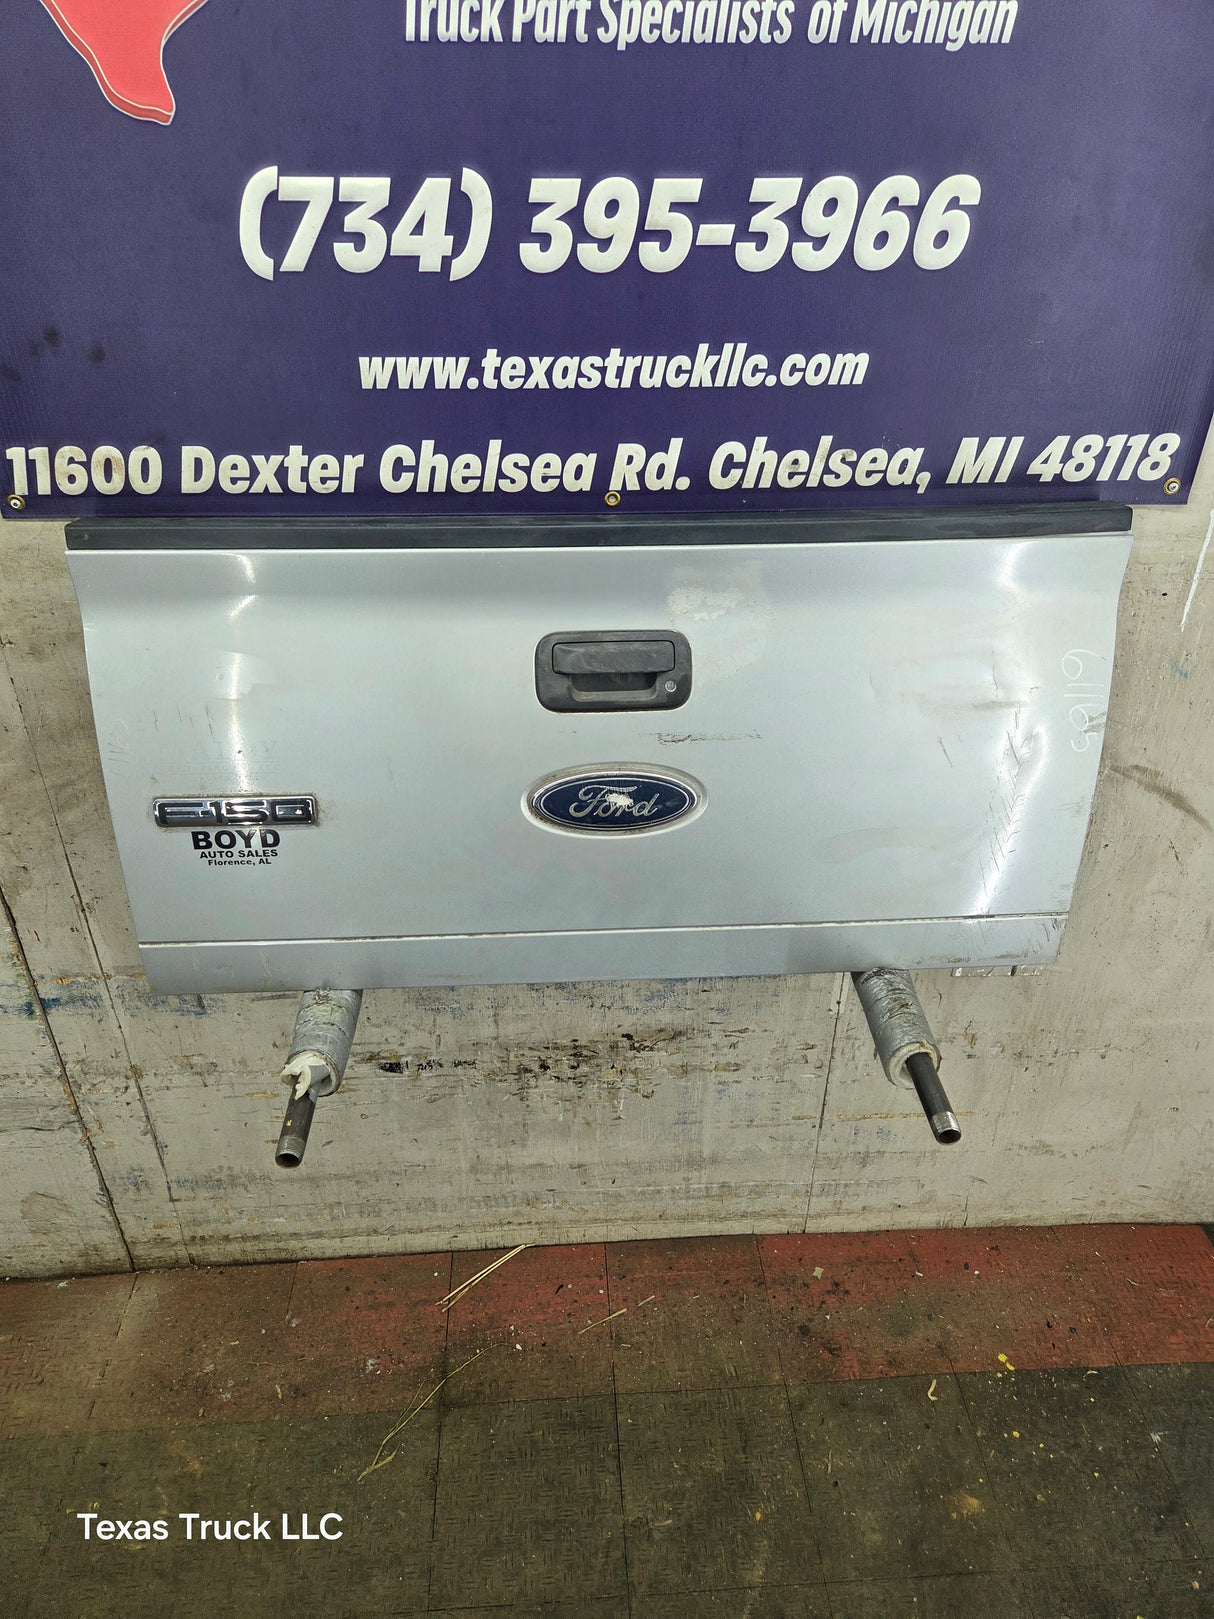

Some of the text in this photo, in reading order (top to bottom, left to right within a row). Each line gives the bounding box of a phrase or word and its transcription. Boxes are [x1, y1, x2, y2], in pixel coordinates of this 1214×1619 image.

[406, 0, 1018, 51] Truck Part Specialists of Michigan
[240, 166, 981, 281] (734) 395-3966
[359, 343, 869, 389] www.texastruckllc.com
[6, 433, 1181, 496] 11600 Dexter Chelsea Rd. Chelsea, MI 48118
[568, 784, 660, 818] Ford
[191, 829, 280, 850] BOYD
[200, 849, 278, 859] AUTO SALES
[259, 857, 272, 865] AL
